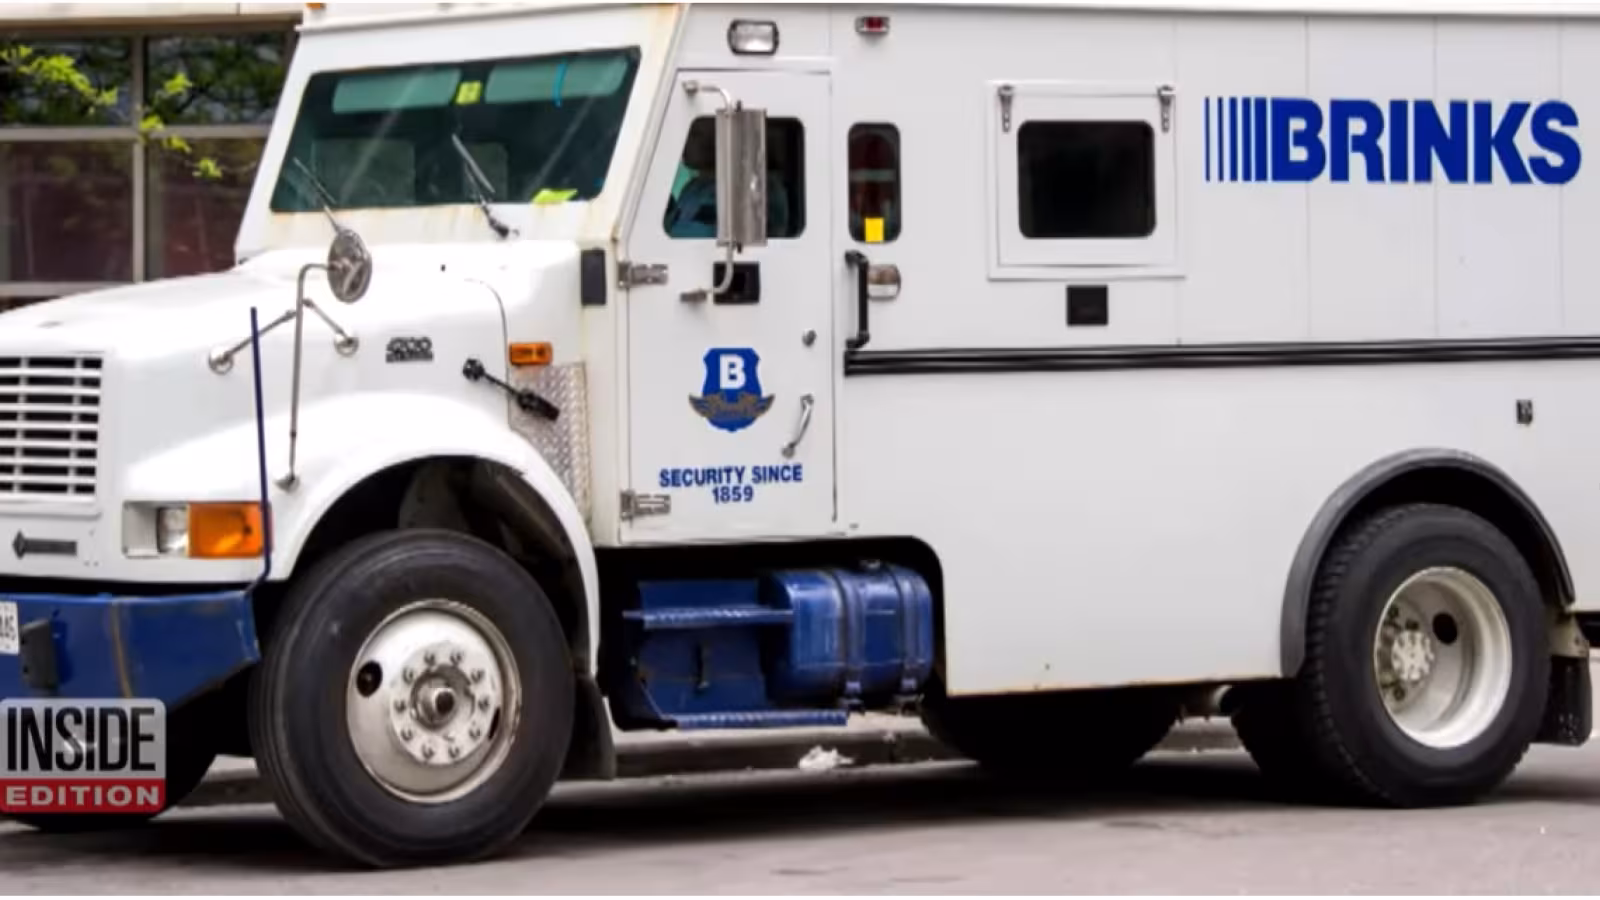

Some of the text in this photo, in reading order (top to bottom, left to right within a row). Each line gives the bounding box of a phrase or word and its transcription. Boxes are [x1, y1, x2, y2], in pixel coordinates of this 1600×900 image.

[1270, 97, 1582, 185] BRINKS
[719, 353, 746, 389] B
[659, 464, 803, 488] SECURITY SINCE
[712, 486, 753, 504] 1859
